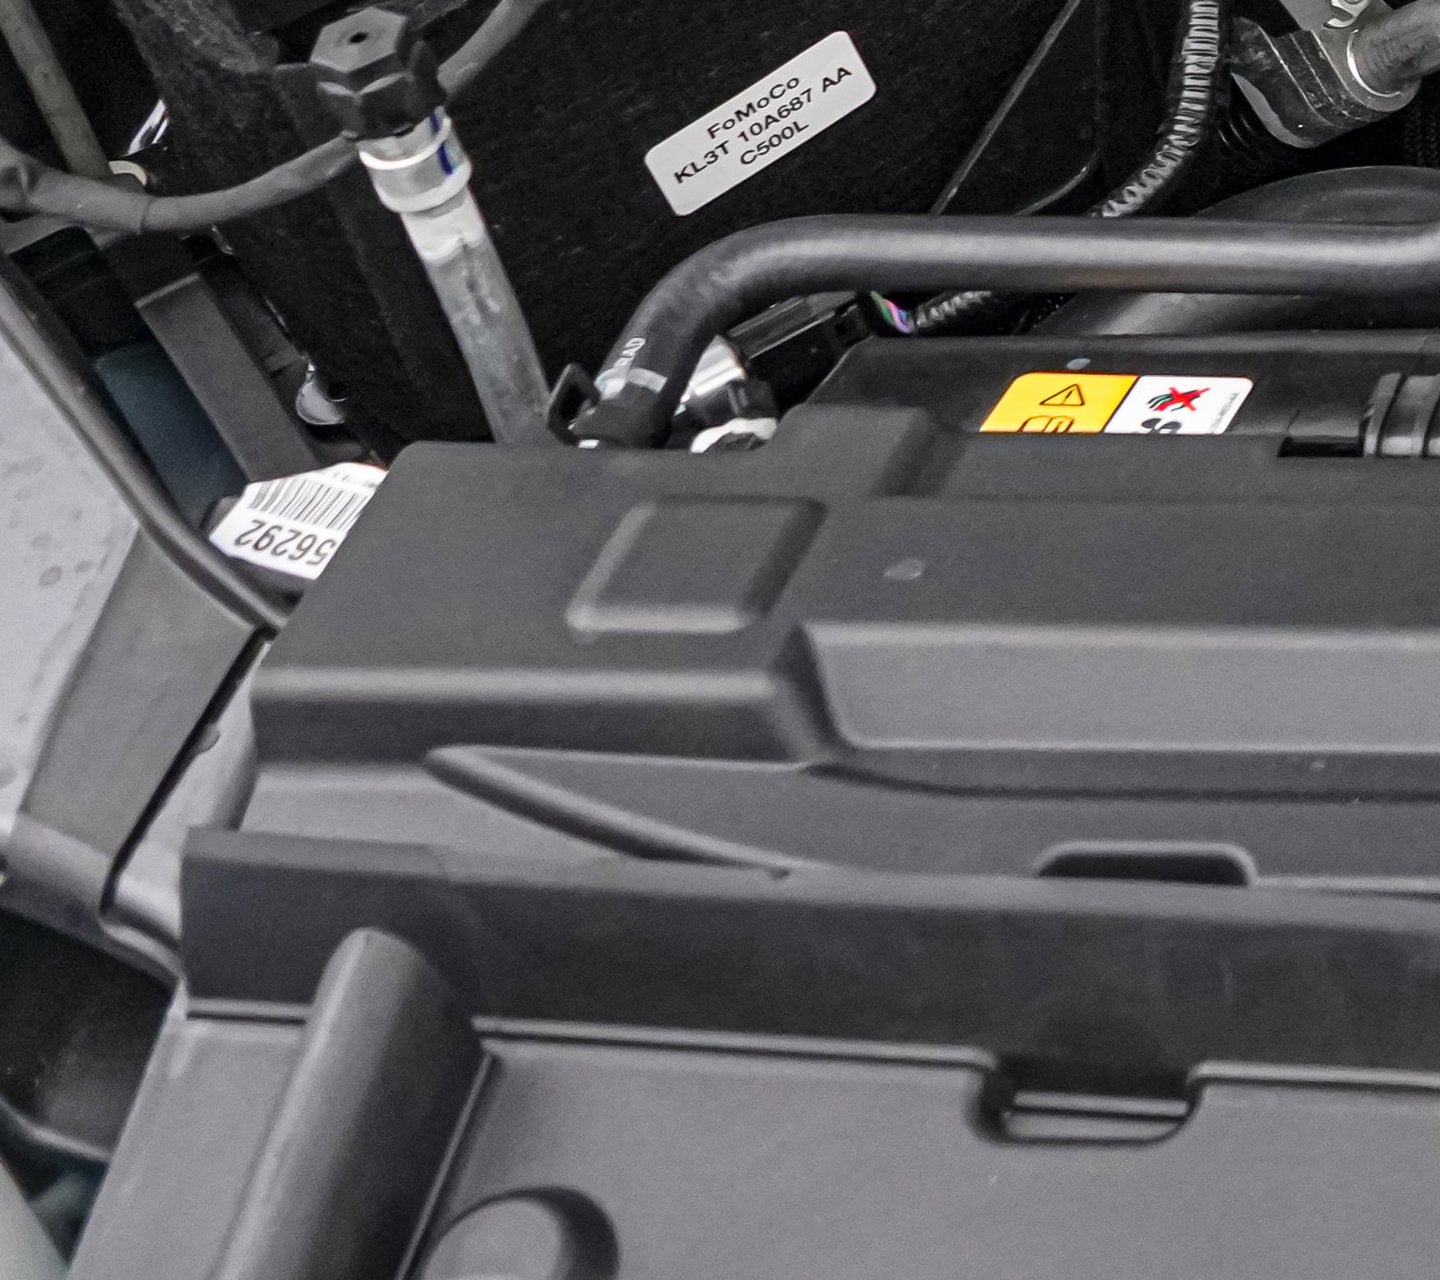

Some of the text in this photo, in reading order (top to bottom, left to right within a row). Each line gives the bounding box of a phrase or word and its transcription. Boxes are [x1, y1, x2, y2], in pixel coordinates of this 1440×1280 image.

[673, 66, 853, 184] KL3T 10A687 AA
[706, 76, 801, 140] FoMoCo
[739, 120, 810, 166] C500L
[234, 519, 338, 566] 56292
